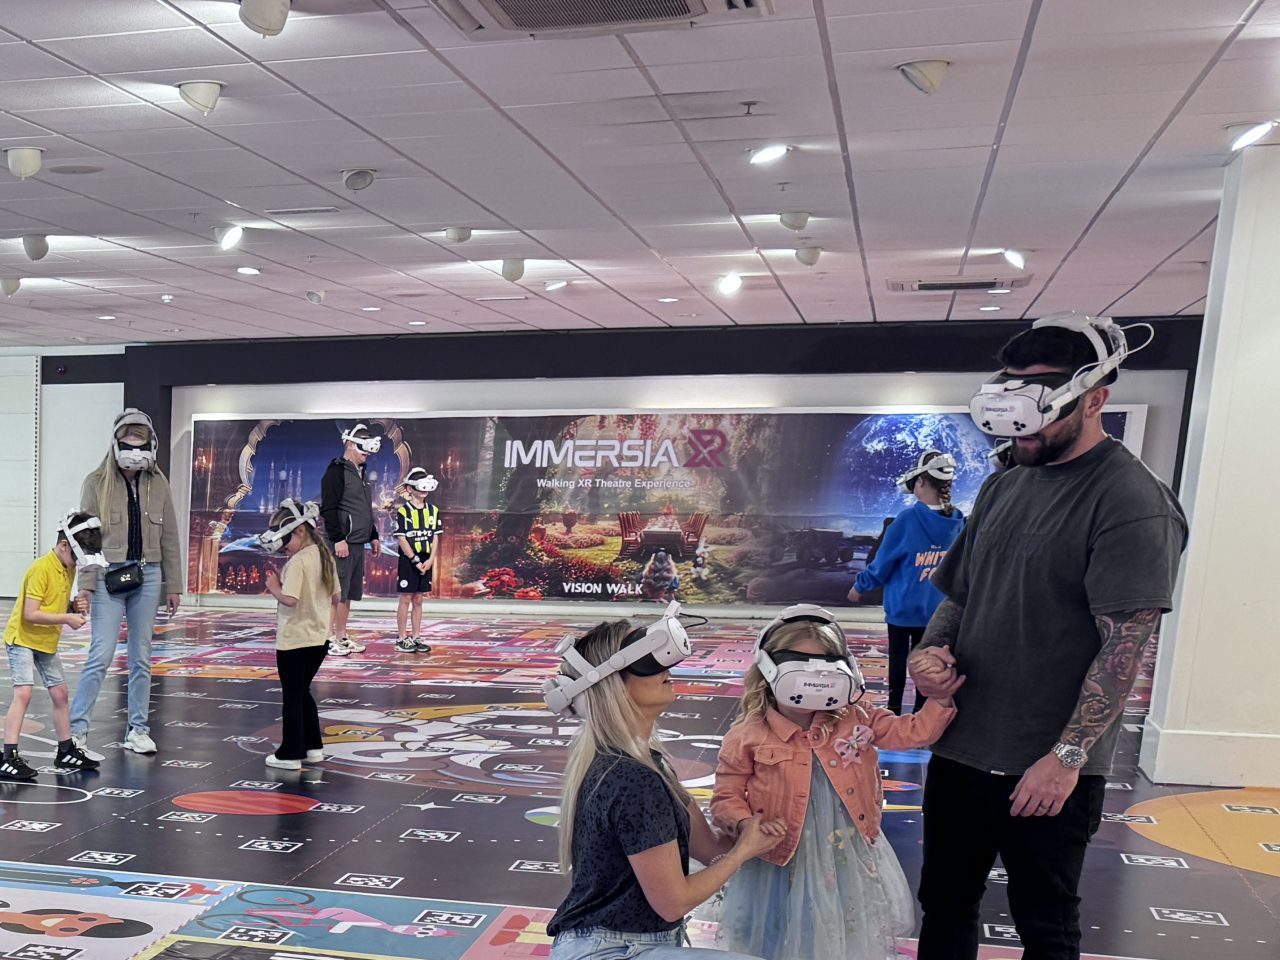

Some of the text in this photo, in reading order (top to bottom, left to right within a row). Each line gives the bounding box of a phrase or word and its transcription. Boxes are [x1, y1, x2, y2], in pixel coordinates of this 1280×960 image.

[504, 439, 680, 468] IMMERSIA
[536, 478, 691, 490] Walking XR Theatre Experience
[915, 550, 947, 567] WHIT
[562, 582, 643, 595] VISION WALK
